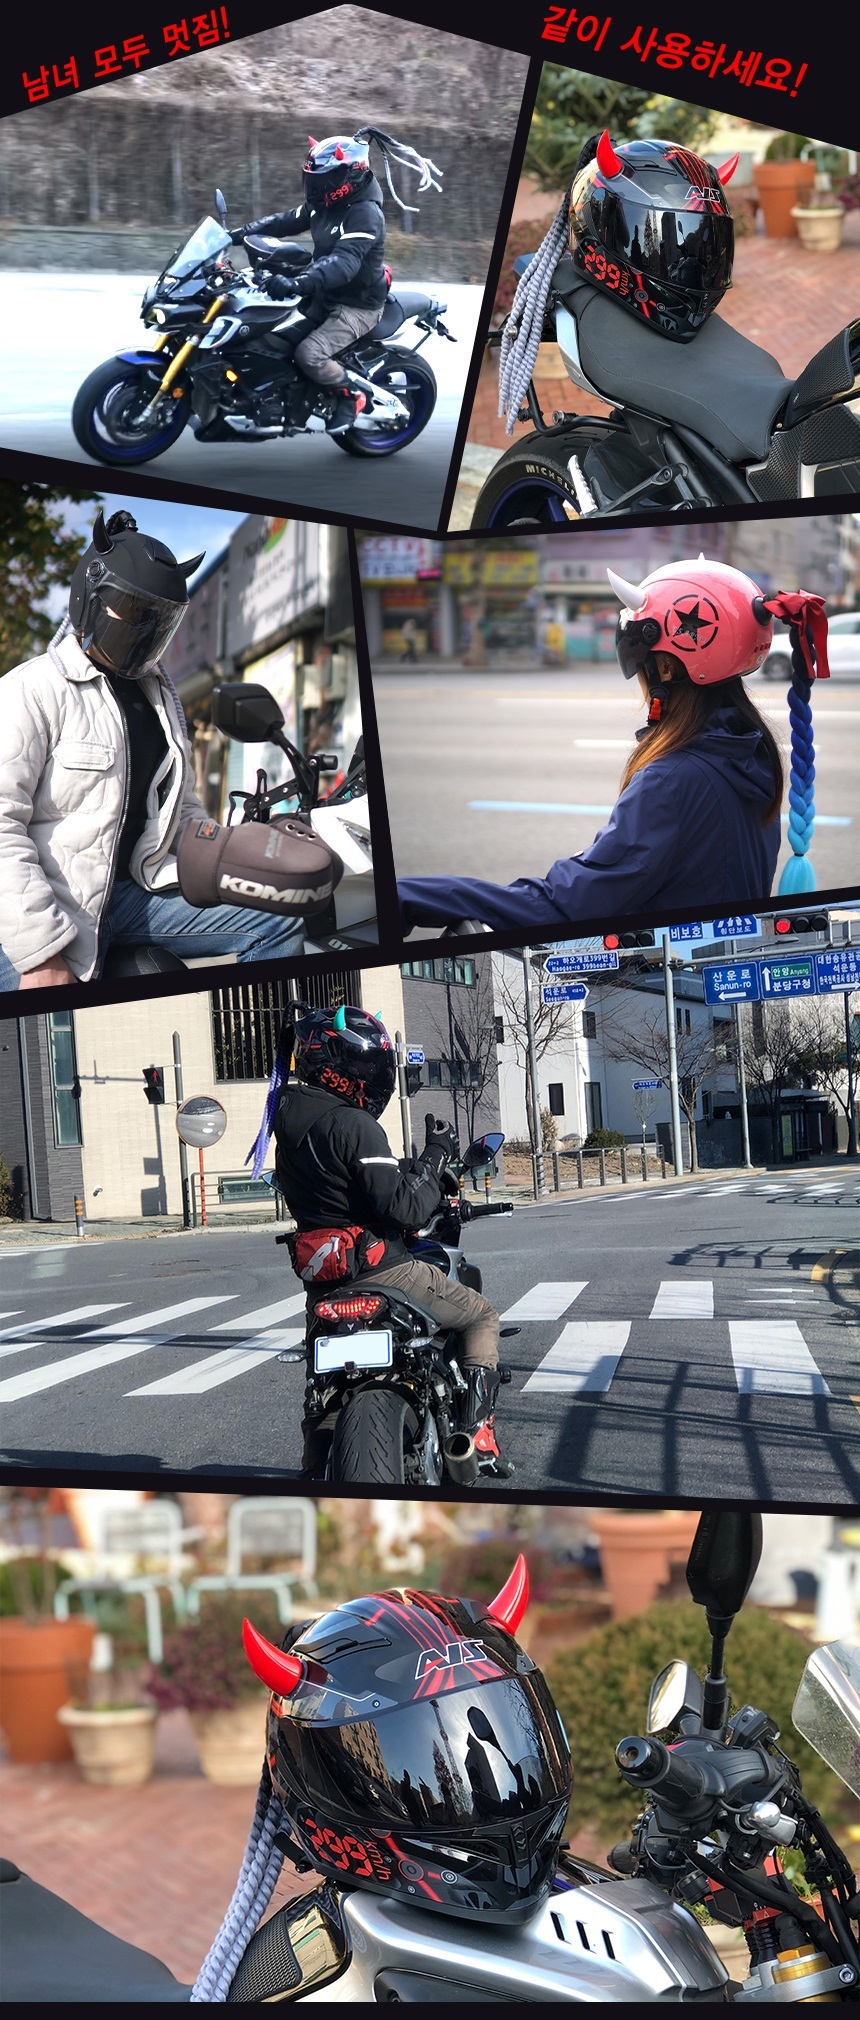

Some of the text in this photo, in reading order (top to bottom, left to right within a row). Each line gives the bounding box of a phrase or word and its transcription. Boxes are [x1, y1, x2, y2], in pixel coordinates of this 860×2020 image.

[330, 184, 350, 200] 299
[584, 244, 631, 297] 299 km/h
[219, 874, 333, 904] KOMINE
[670, 926, 702, 940] 비보호
[720, 925, 752, 935] 횡단보도
[713, 969, 751, 983] 산운로
[772, 967, 809, 977] 안양 Anyang
[545, 987, 568, 996] 석운로
[714, 981, 752, 991] Sanun-ro
[772, 978, 811, 992] 분당구청
[320, 1067, 350, 1093] 299
[305, 1818, 391, 1880] 299 km/h
